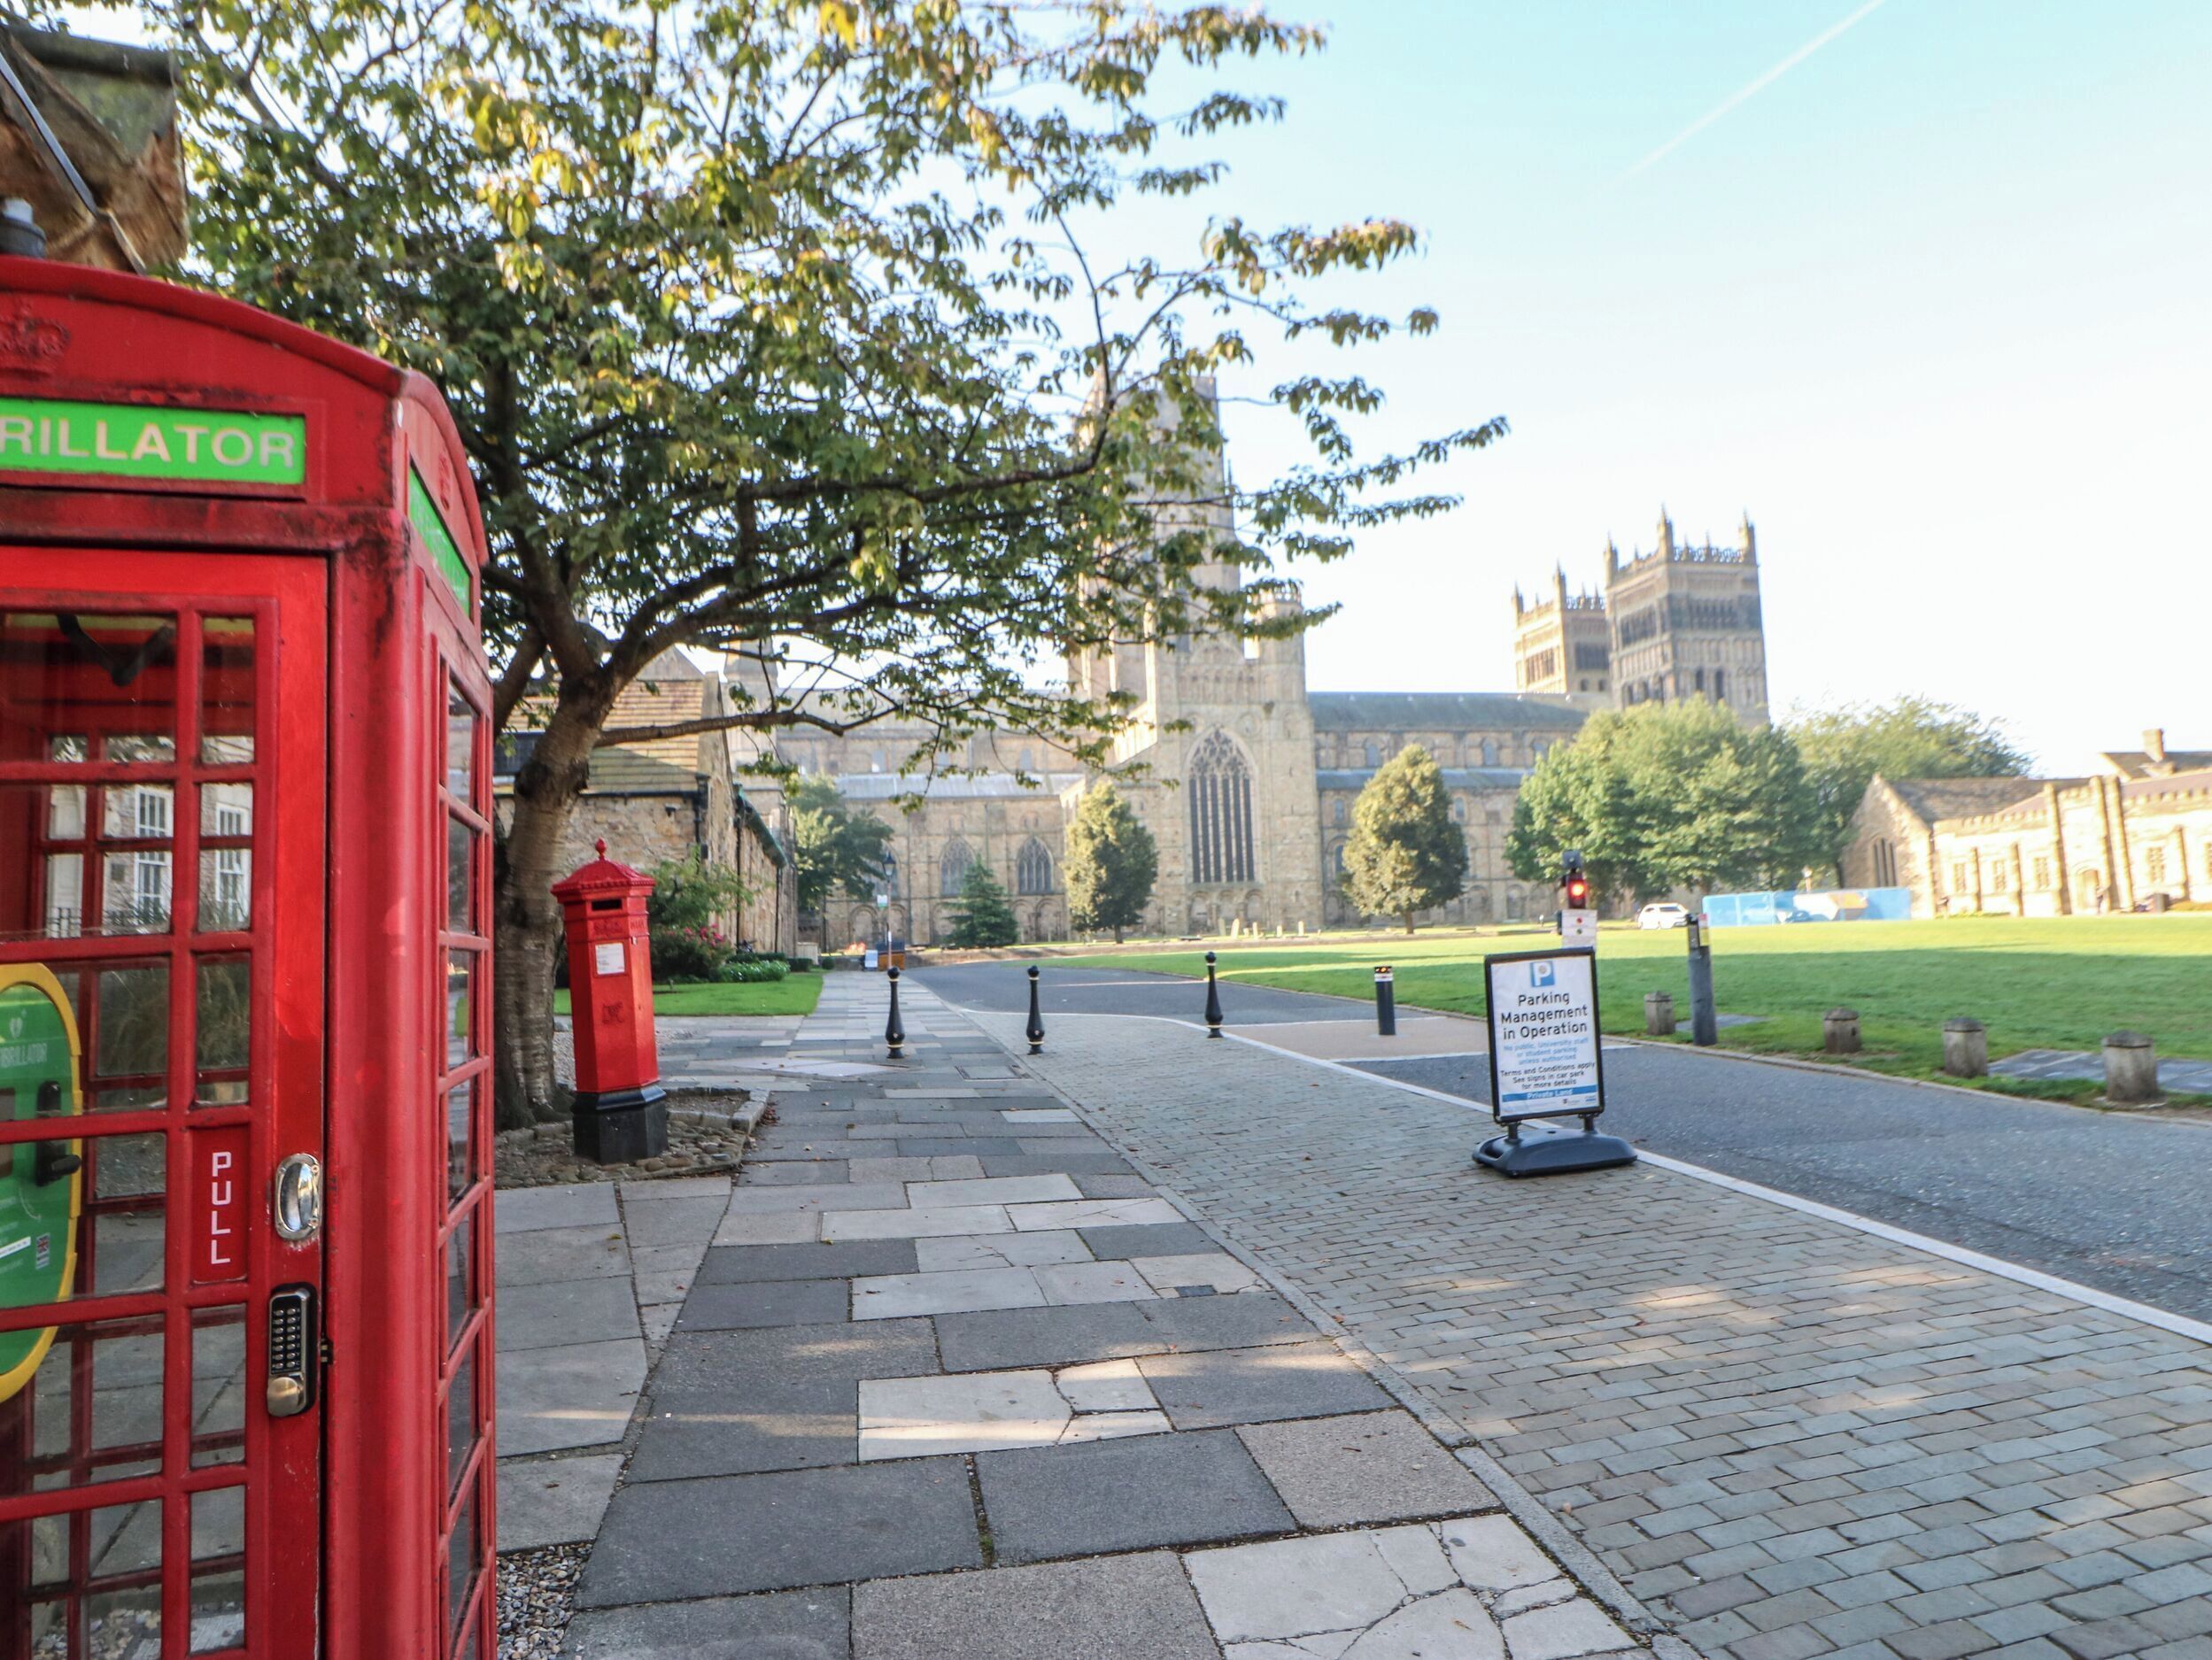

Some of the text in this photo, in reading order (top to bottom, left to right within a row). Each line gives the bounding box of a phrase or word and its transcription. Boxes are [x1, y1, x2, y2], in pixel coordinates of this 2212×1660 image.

[1518, 992, 1570, 1007] Parking
[1501, 1004, 1589, 1025] Management
[1503, 1021, 1588, 1040] in Operation
[1538, 1039, 1572, 1048] University
[1552, 1046, 1577, 1055] parking
[1538, 1063, 1575, 1073] Conditions
[1577, 1061, 1595, 1070] apply
[1527, 1074, 1545, 1083] signs
[1569, 1070, 1584, 1079] park
[1552, 1078, 1577, 1087] details
[1527, 1089, 1574, 1100] Private Land
[211, 1151, 231, 1264] PULL
